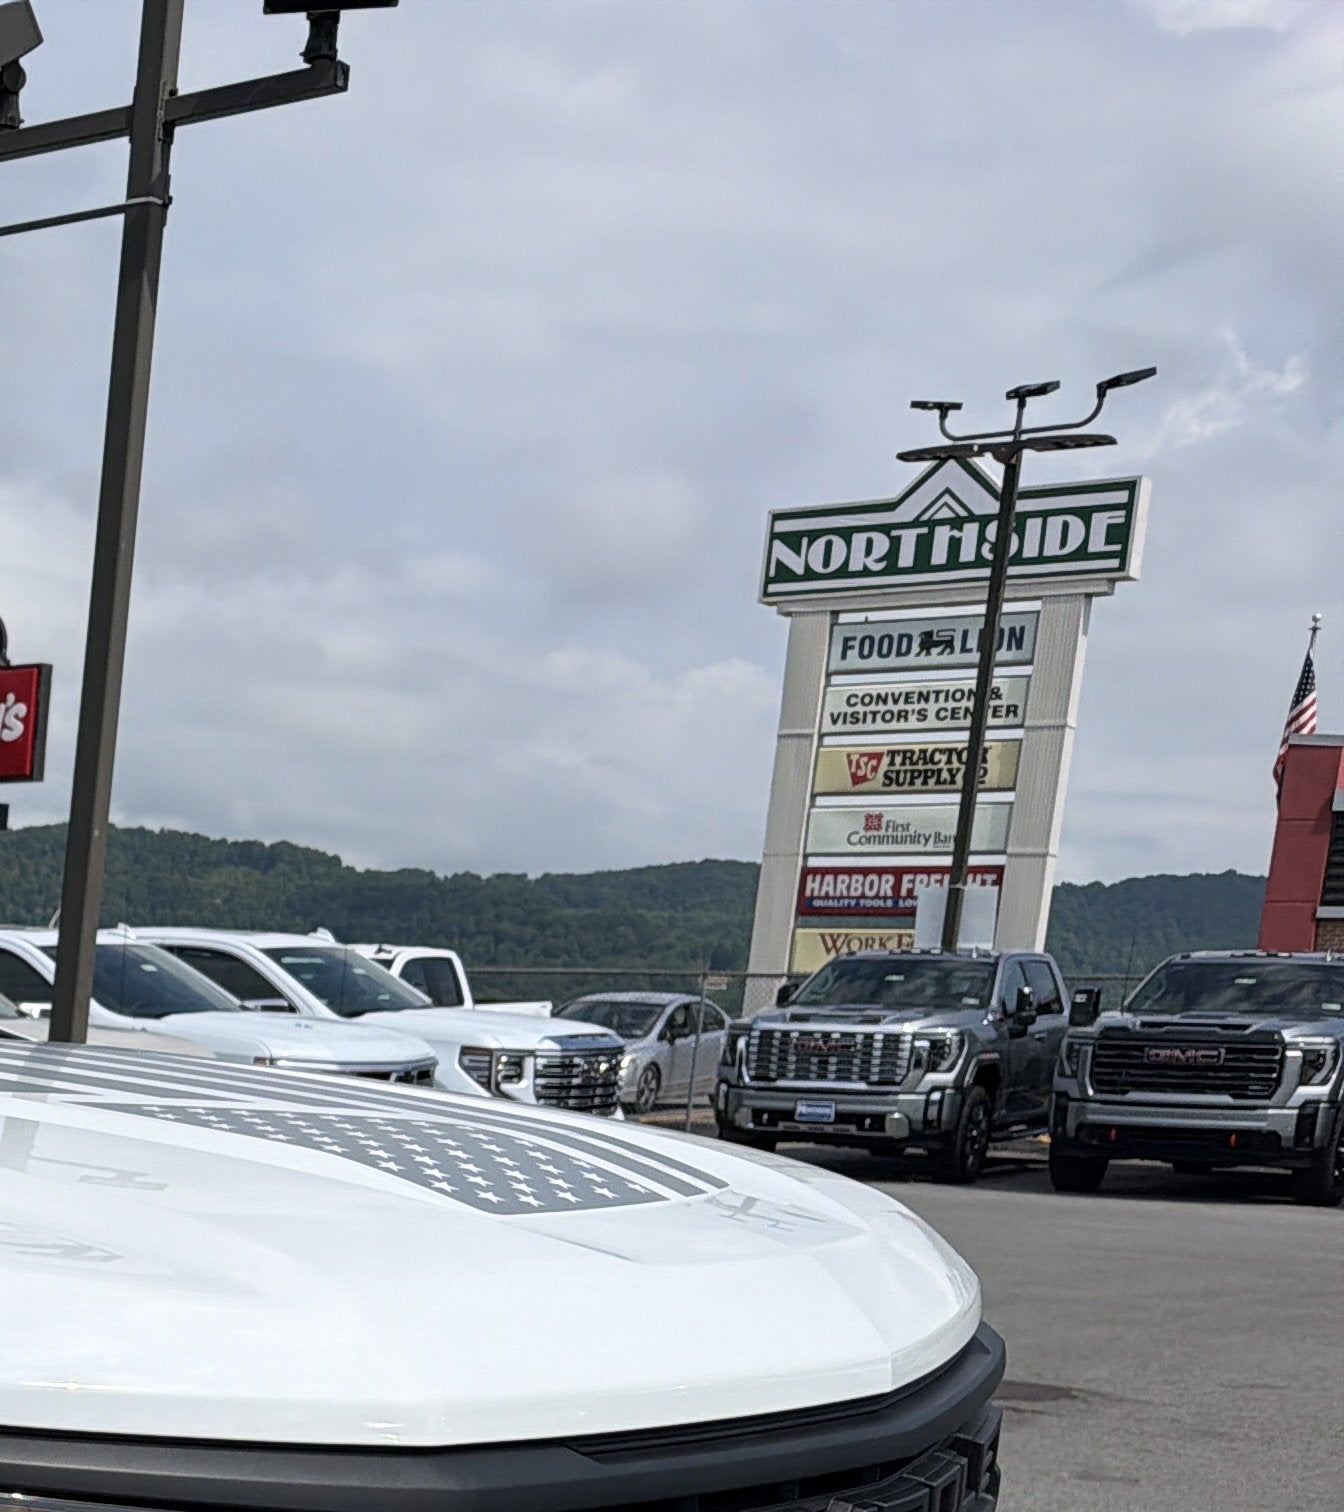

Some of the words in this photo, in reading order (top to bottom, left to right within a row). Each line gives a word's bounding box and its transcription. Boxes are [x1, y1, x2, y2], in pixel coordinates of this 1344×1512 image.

[840, 632, 914, 661] FOOD
[846, 686, 977, 708] CONVENTION
[990, 686, 1003, 701] &
[830, 707, 928, 726] VISITOR'S
[935, 704, 1020, 721] CENER
[849, 753, 879, 780] TSC
[881, 766, 962, 788] SUPPLY
[884, 819, 912, 833] First
[846, 829, 932, 848] Community
[805, 873, 896, 898] HARBOR
[1148, 1047, 1220, 1066] GMC
